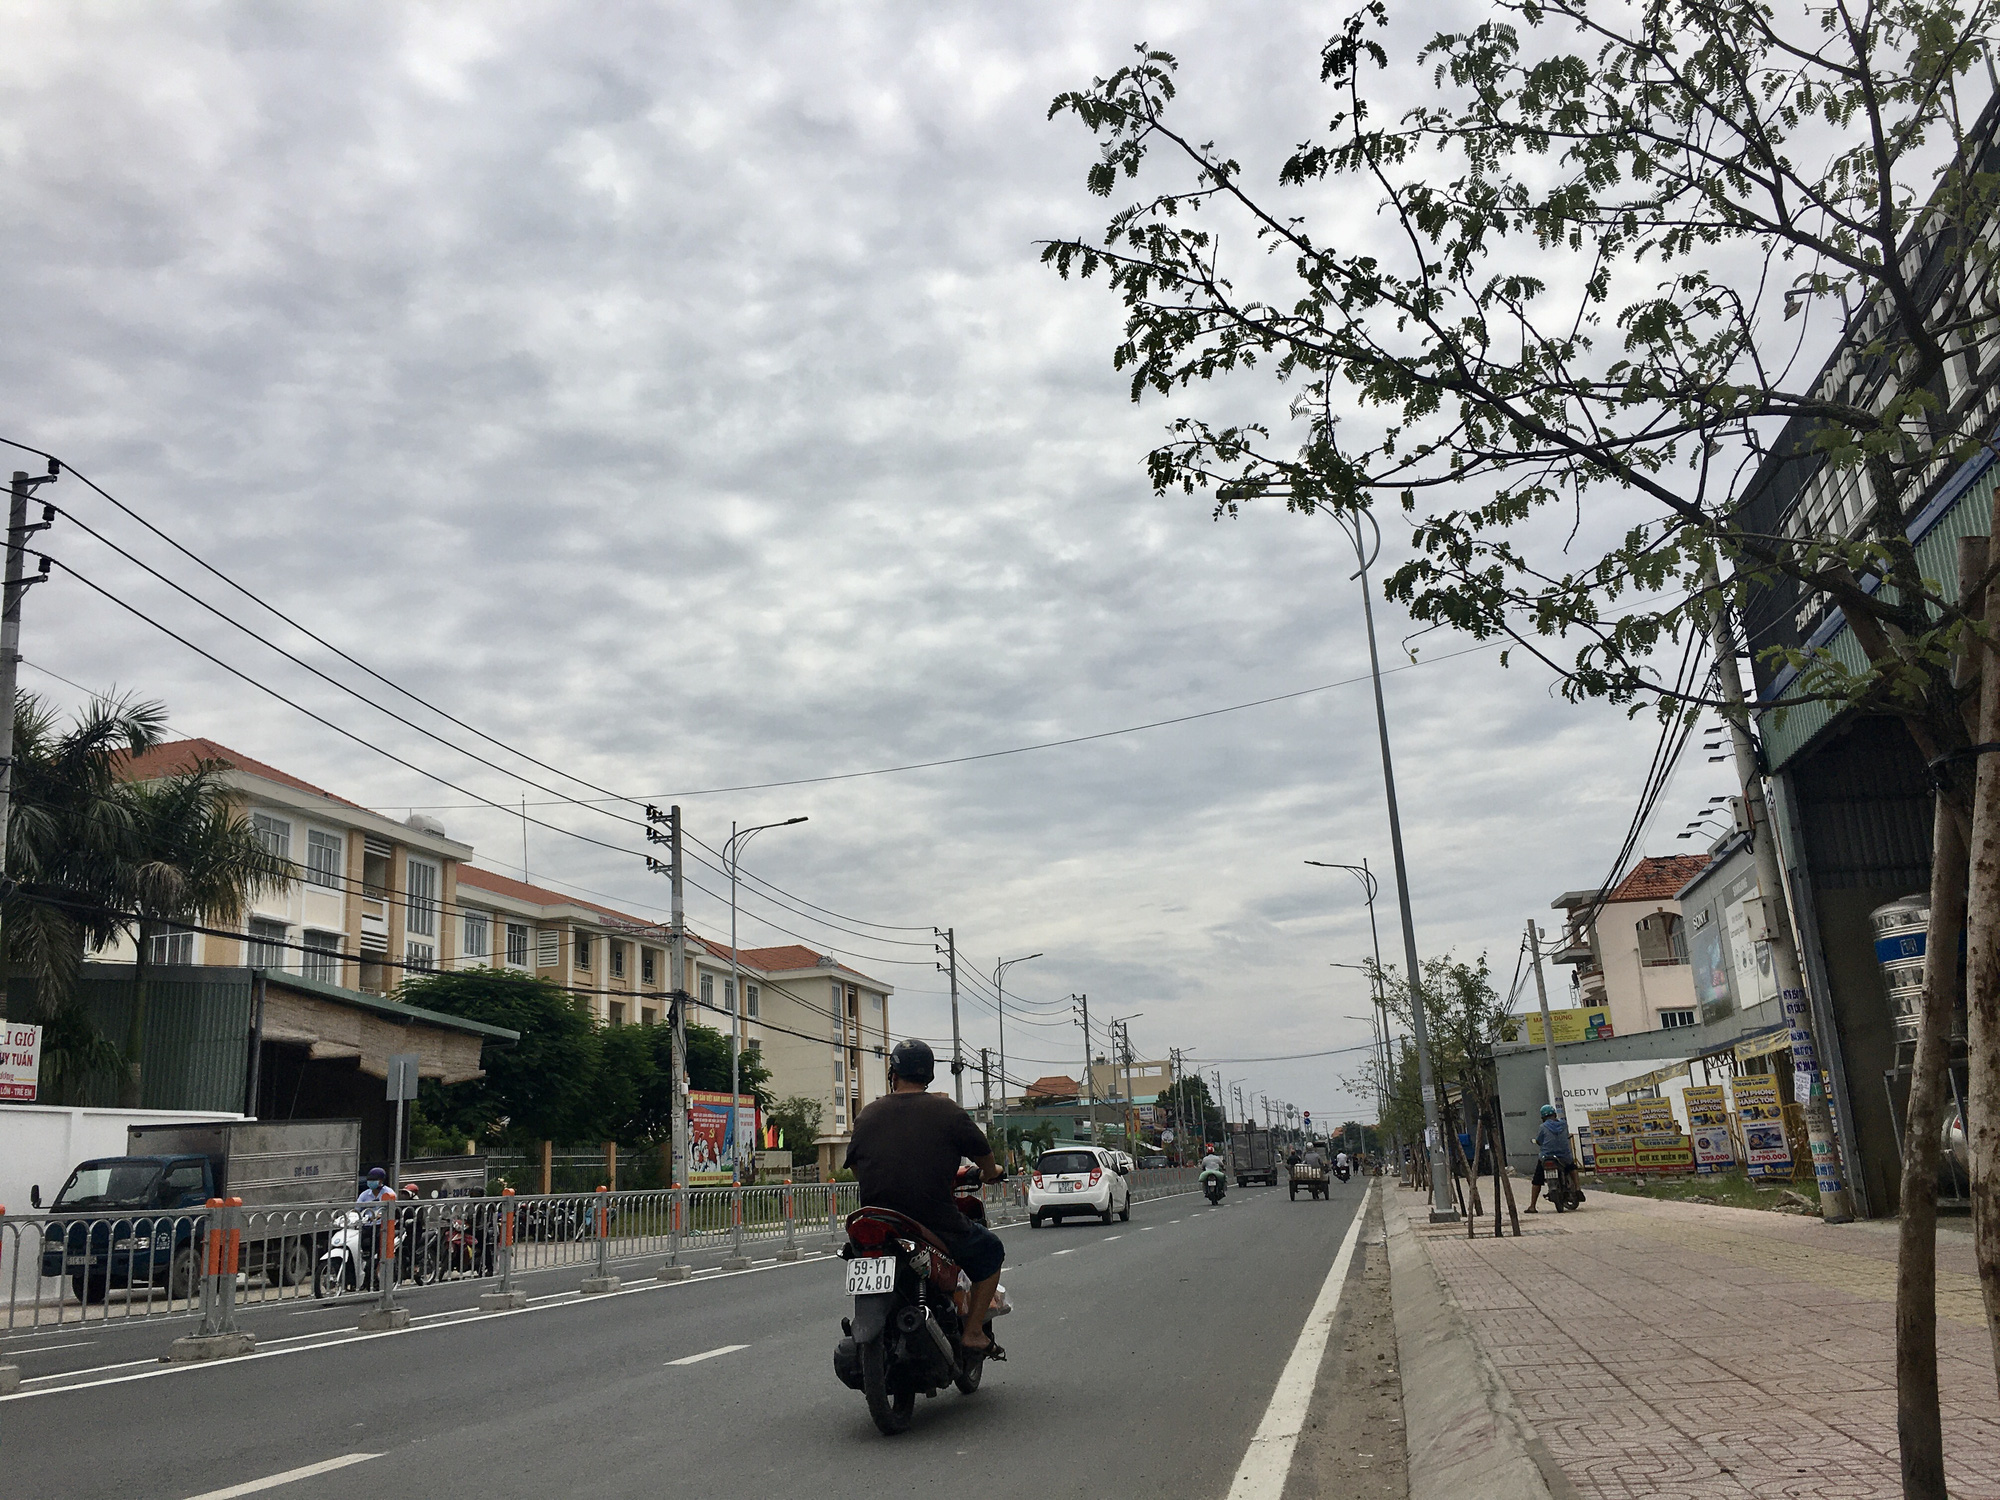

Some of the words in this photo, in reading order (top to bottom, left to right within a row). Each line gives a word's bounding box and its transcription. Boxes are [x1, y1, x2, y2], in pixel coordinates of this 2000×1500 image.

[1693, 910, 1708, 930] SONY
[15, 1028, 36, 1047] GIỜ
[12, 1050, 33, 1067] TUẤN
[24, 1088, 32, 1097] EM
[1562, 1089, 1586, 1098] OLED
[1588, 1088, 1599, 1096] TV
[1735, 1089, 1749, 1098] GIẢI
[1750, 1088, 1776, 1097] PHÓNG
[1738, 1097, 1760, 1106] HÀNG
[1760, 1096, 1776, 1104] TỒN
[1751, 1153, 1787, 1161] 2.790.000
[854, 1259, 887, 1276] 59-Y1
[848, 1275, 891, 1293] 024.80
